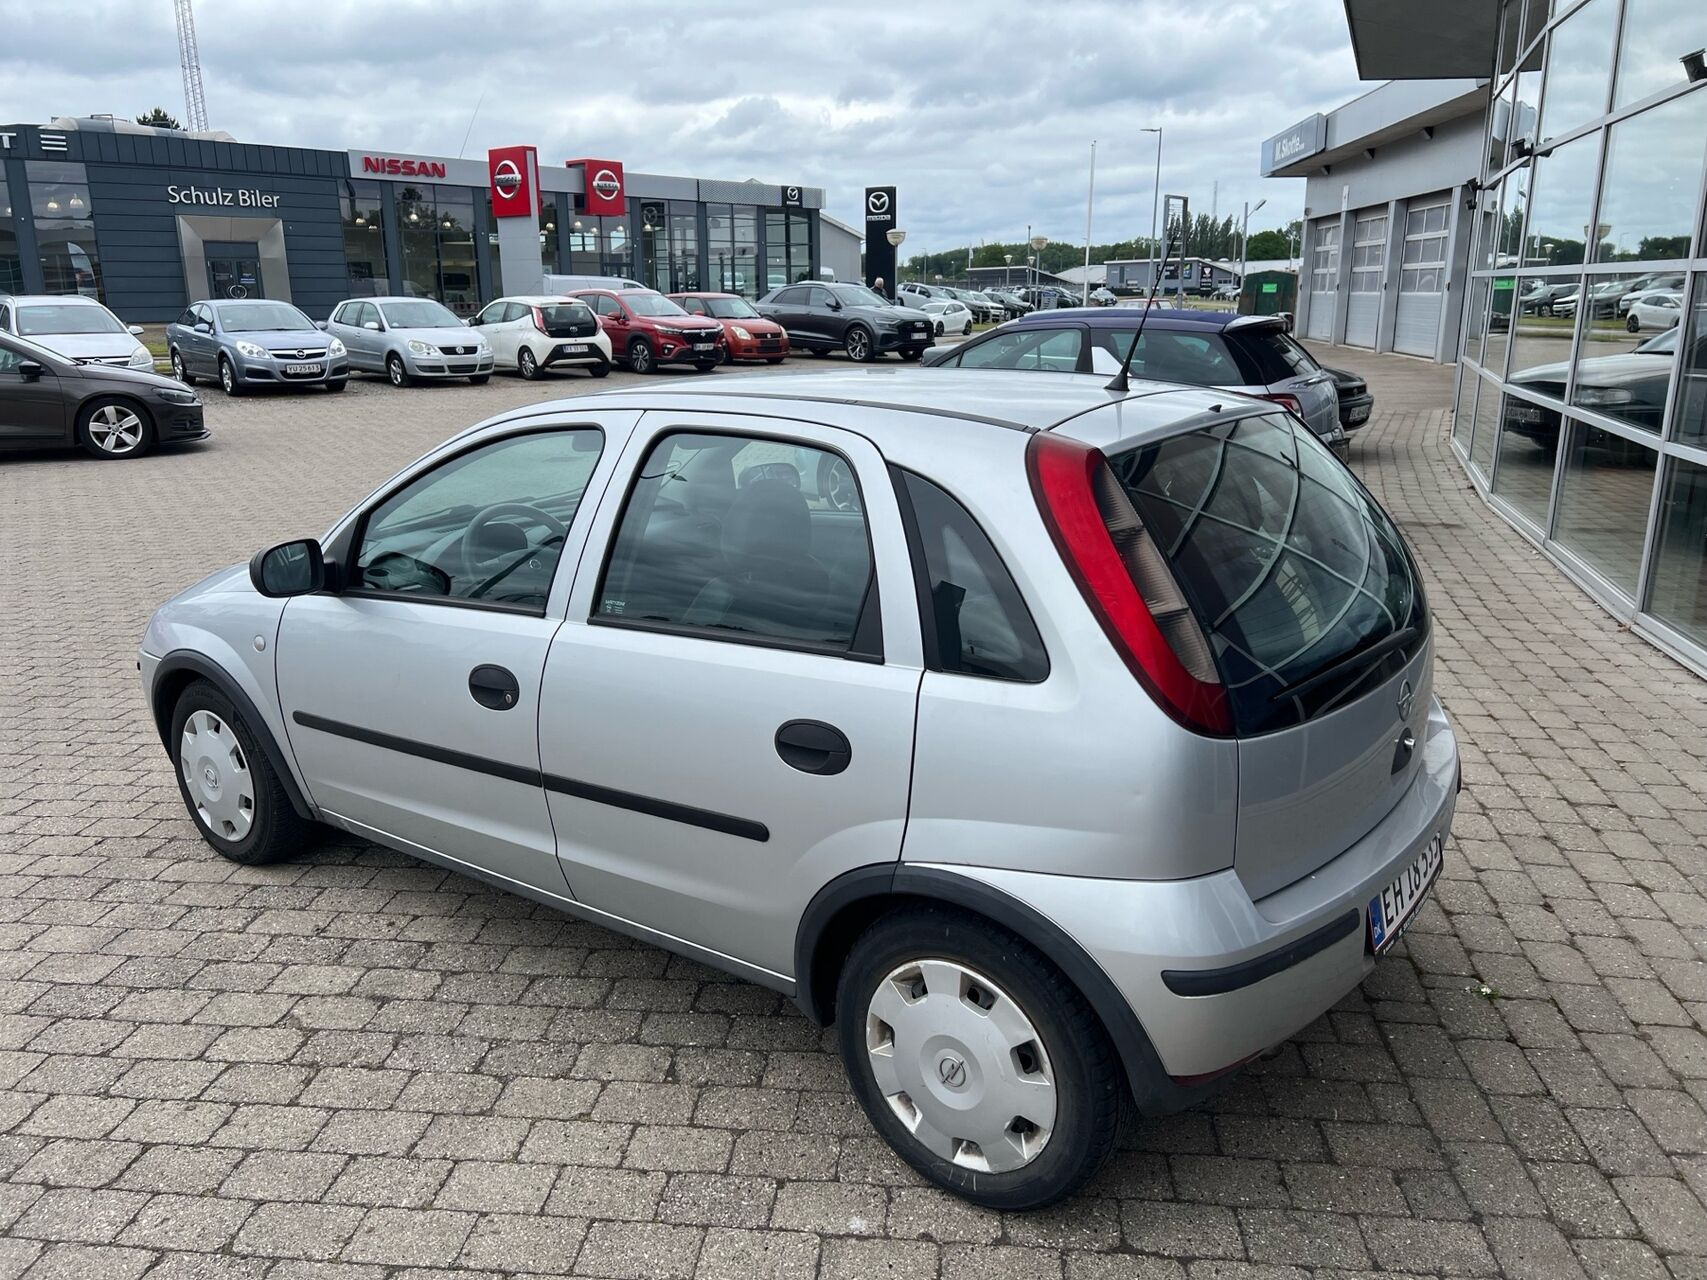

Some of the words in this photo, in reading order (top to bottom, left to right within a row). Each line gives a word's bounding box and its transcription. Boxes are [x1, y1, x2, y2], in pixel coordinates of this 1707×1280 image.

[363, 156, 446, 178] NISSAN
[167, 185, 235, 206] Schulz
[238, 189, 280, 208] Biler
[1382, 877, 1405, 928] EH
